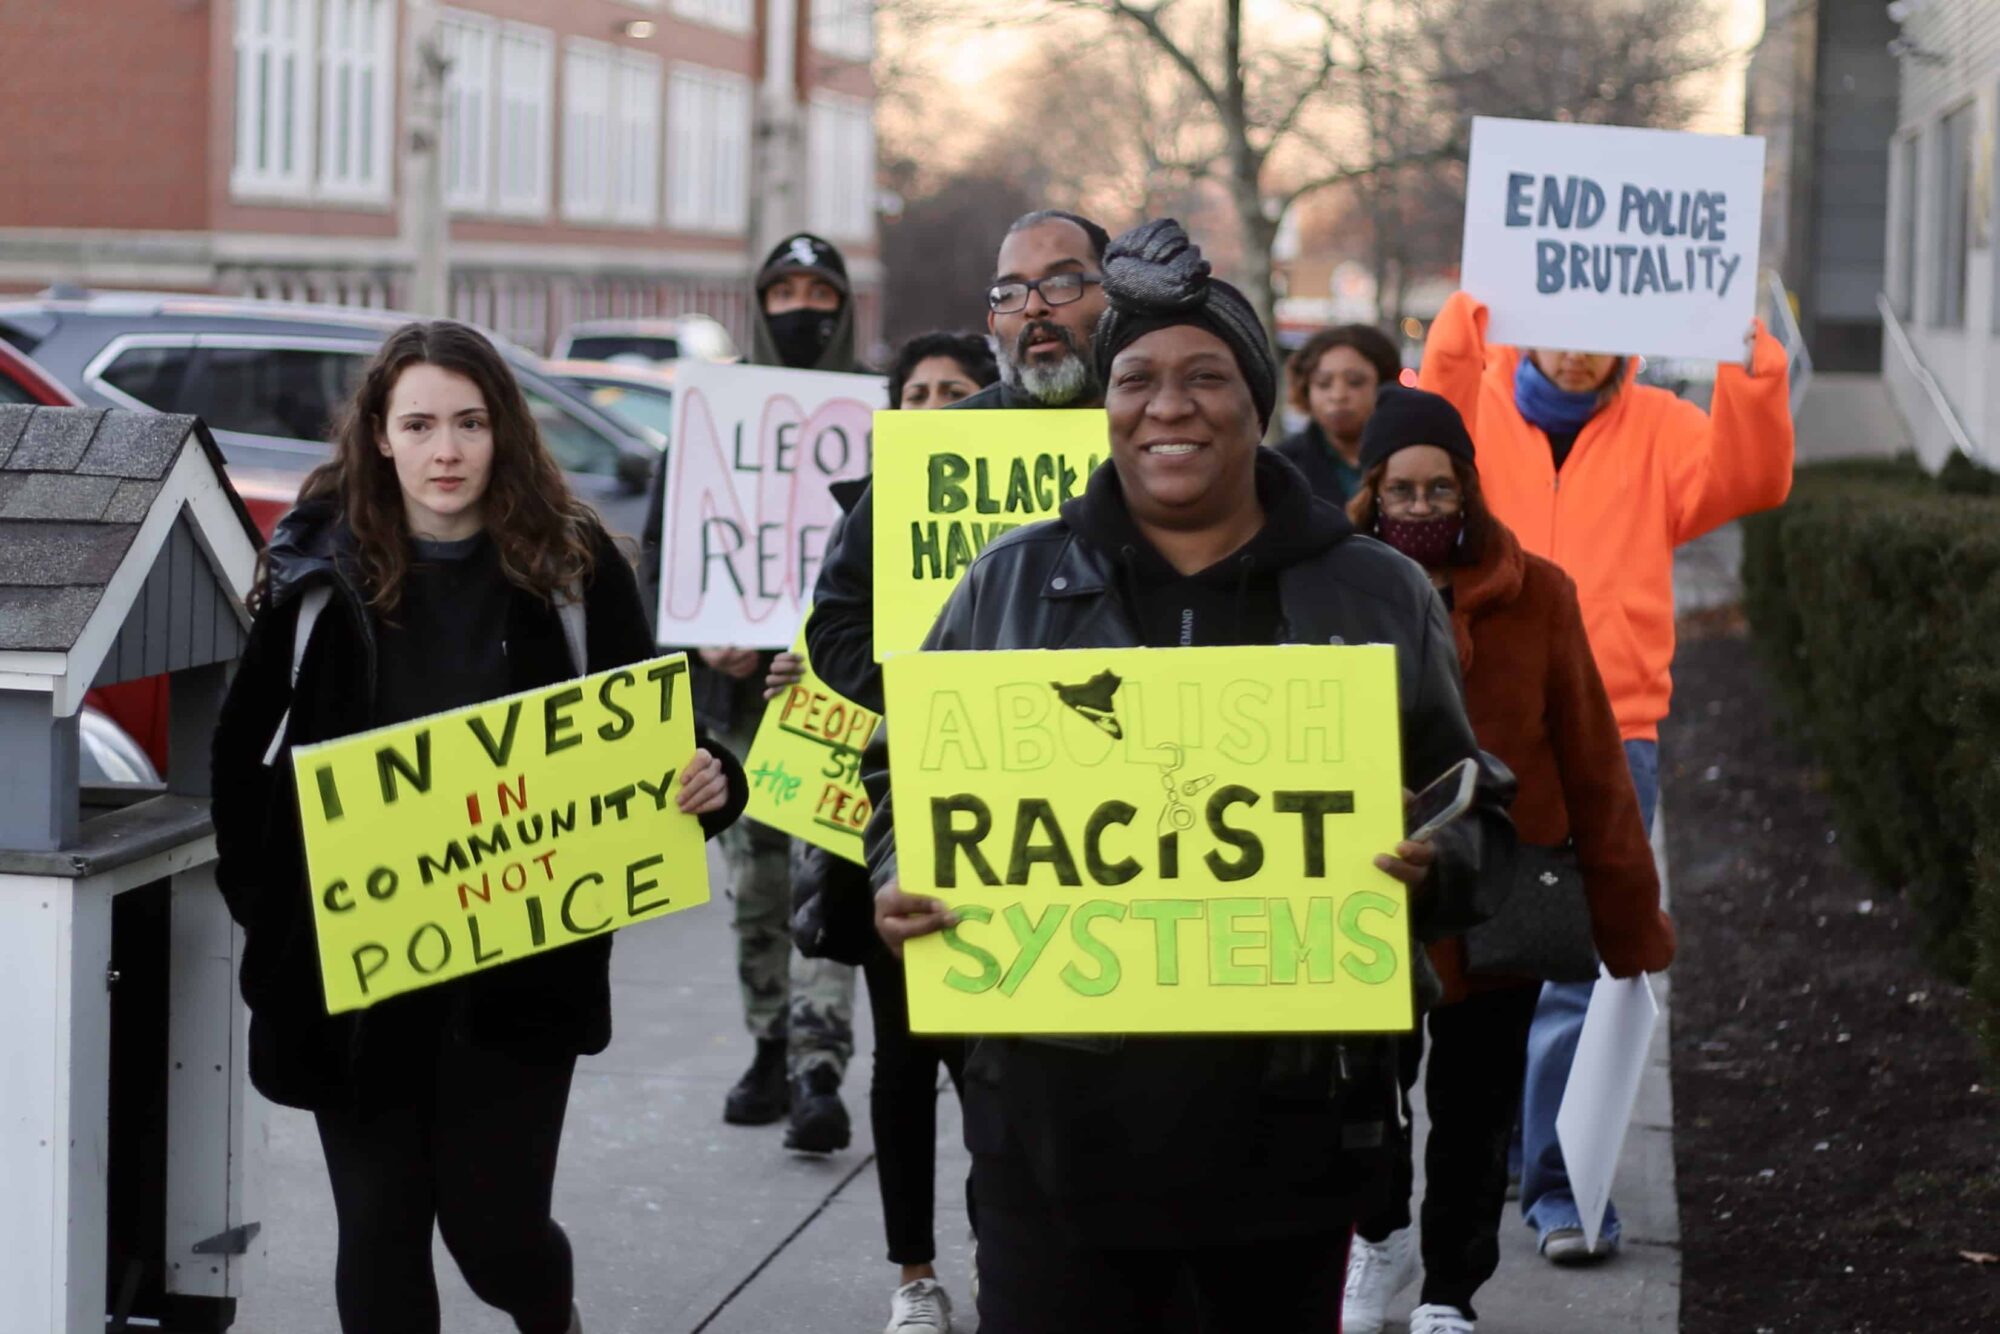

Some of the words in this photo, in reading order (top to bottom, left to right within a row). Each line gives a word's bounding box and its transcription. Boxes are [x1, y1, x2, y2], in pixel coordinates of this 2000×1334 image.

[1505, 172, 1606, 229] END
[1619, 183, 1726, 241] POLICE
[1536, 238, 1741, 298] BRUTALITY
[928, 452, 1077, 514] BLACK
[911, 521, 1021, 580] HAV
[315, 661, 686, 823] INVEST
[920, 676, 1345, 772] ABOLISH
[323, 767, 677, 914] COMMUNITY
[466, 774, 528, 826] IN
[929, 784, 1355, 888] RACIST
[458, 849, 557, 910] NOT
[352, 854, 670, 996] POLICE
[942, 891, 1399, 998] SYSTEMS
